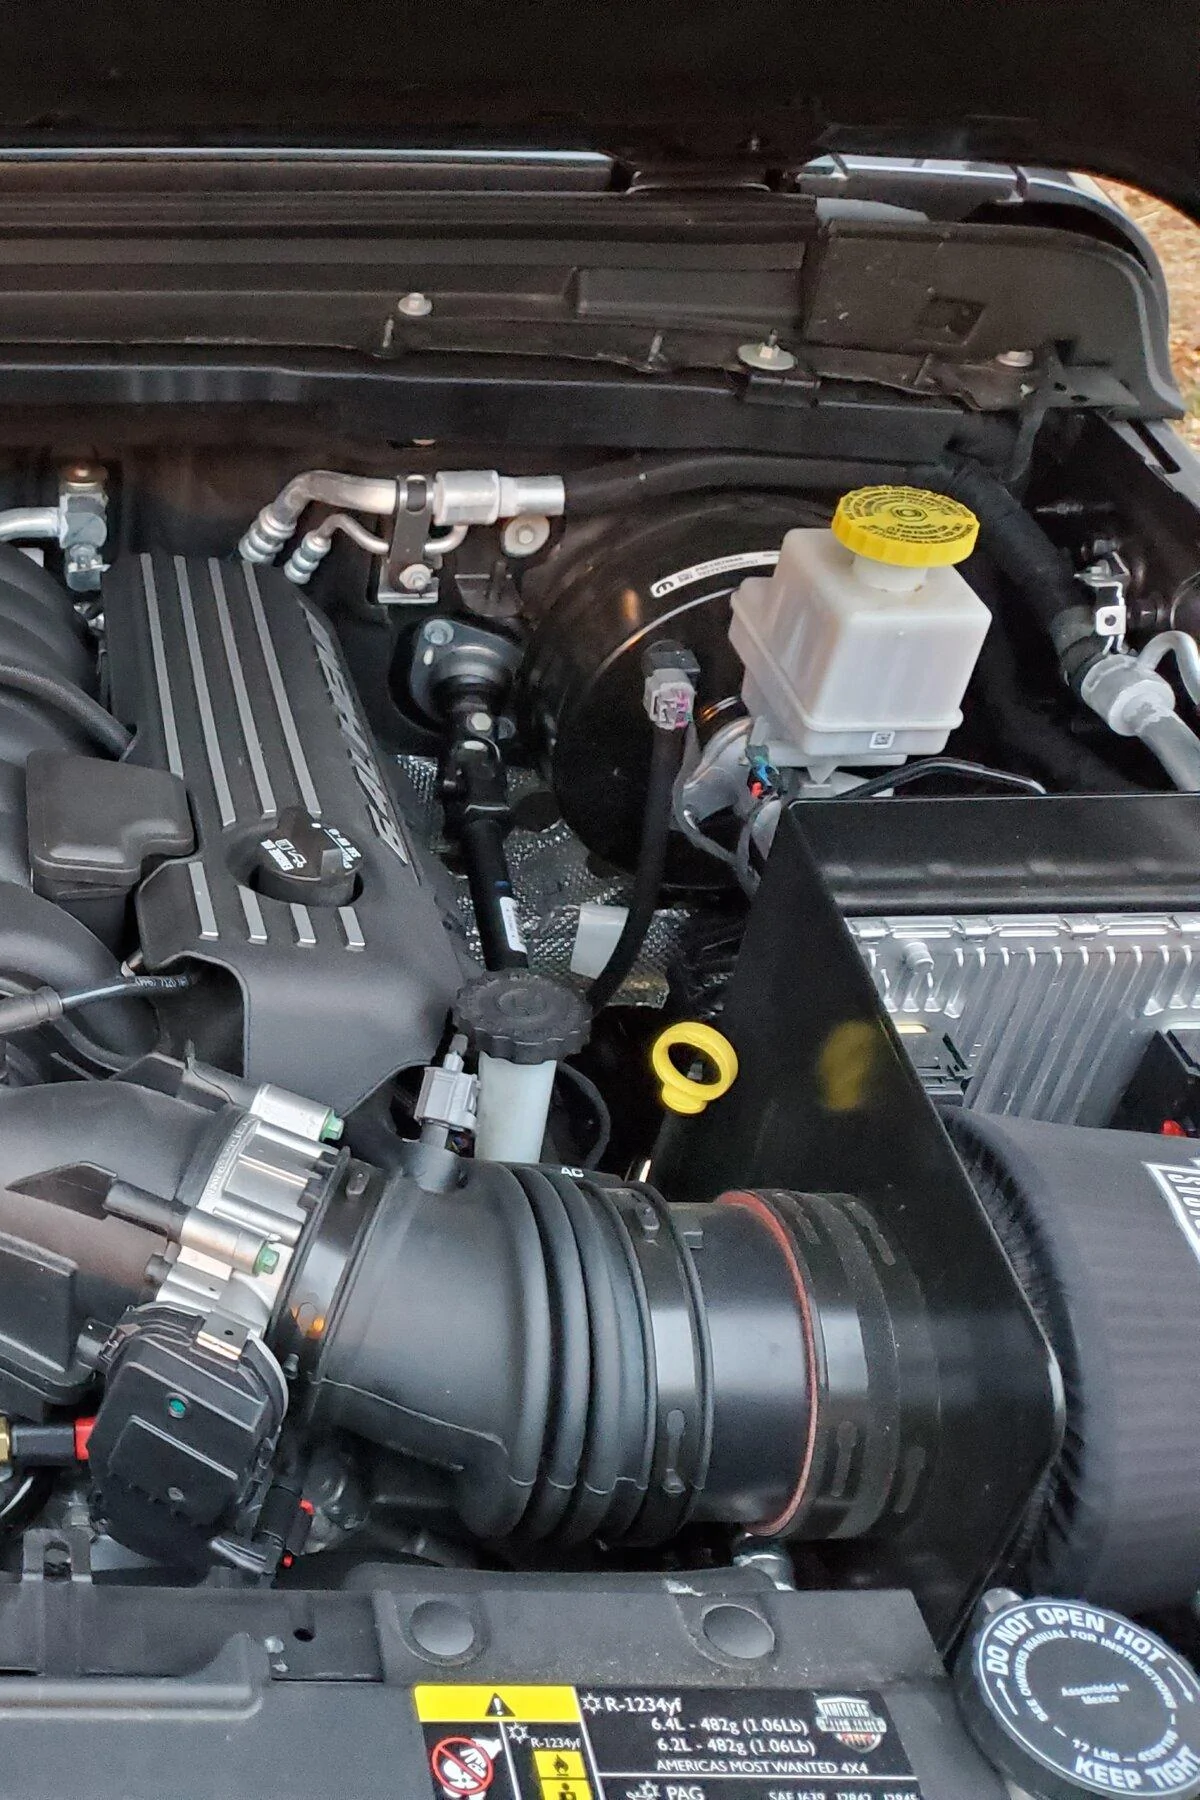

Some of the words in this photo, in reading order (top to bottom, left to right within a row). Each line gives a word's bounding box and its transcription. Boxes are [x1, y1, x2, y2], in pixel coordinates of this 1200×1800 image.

[993, 1611, 1035, 1646] NOT
[1036, 1607, 1105, 1633] OPEN
[1022, 1628, 1069, 1652] MANUAL
[1069, 1629, 1097, 1643] FOR
[1114, 1625, 1166, 1662] HOT
[986, 1645, 1009, 1676] DO
[1014, 1650, 1032, 1697] OWNERS
[1100, 1639, 1177, 1709] INSTRUCTIONS
[605, 1697, 682, 1717] R-1234yf
[1025, 1698, 1049, 1722] SEE
[651, 1717, 686, 1732] 6.4L
[701, 1718, 740, 1735] 482g
[743, 1718, 809, 1737] (1.06Lb)
[531, 1737, 582, 1749] R-1234yf
[657, 1737, 692, 1753] 6.2L
[707, 1738, 747, 1756] 482g
[749, 1739, 816, 1757] (1.06Lb)
[656, 1760, 729, 1774] AMERICAS
[730, 1760, 770, 1774] MOST
[771, 1761, 838, 1774] WANTED
[841, 1762, 869, 1775] 4X4
[1074, 1755, 1143, 1790] KEEP
[1144, 1744, 1200, 1790] TIGHT
[666, 1786, 705, 1800] PAG
